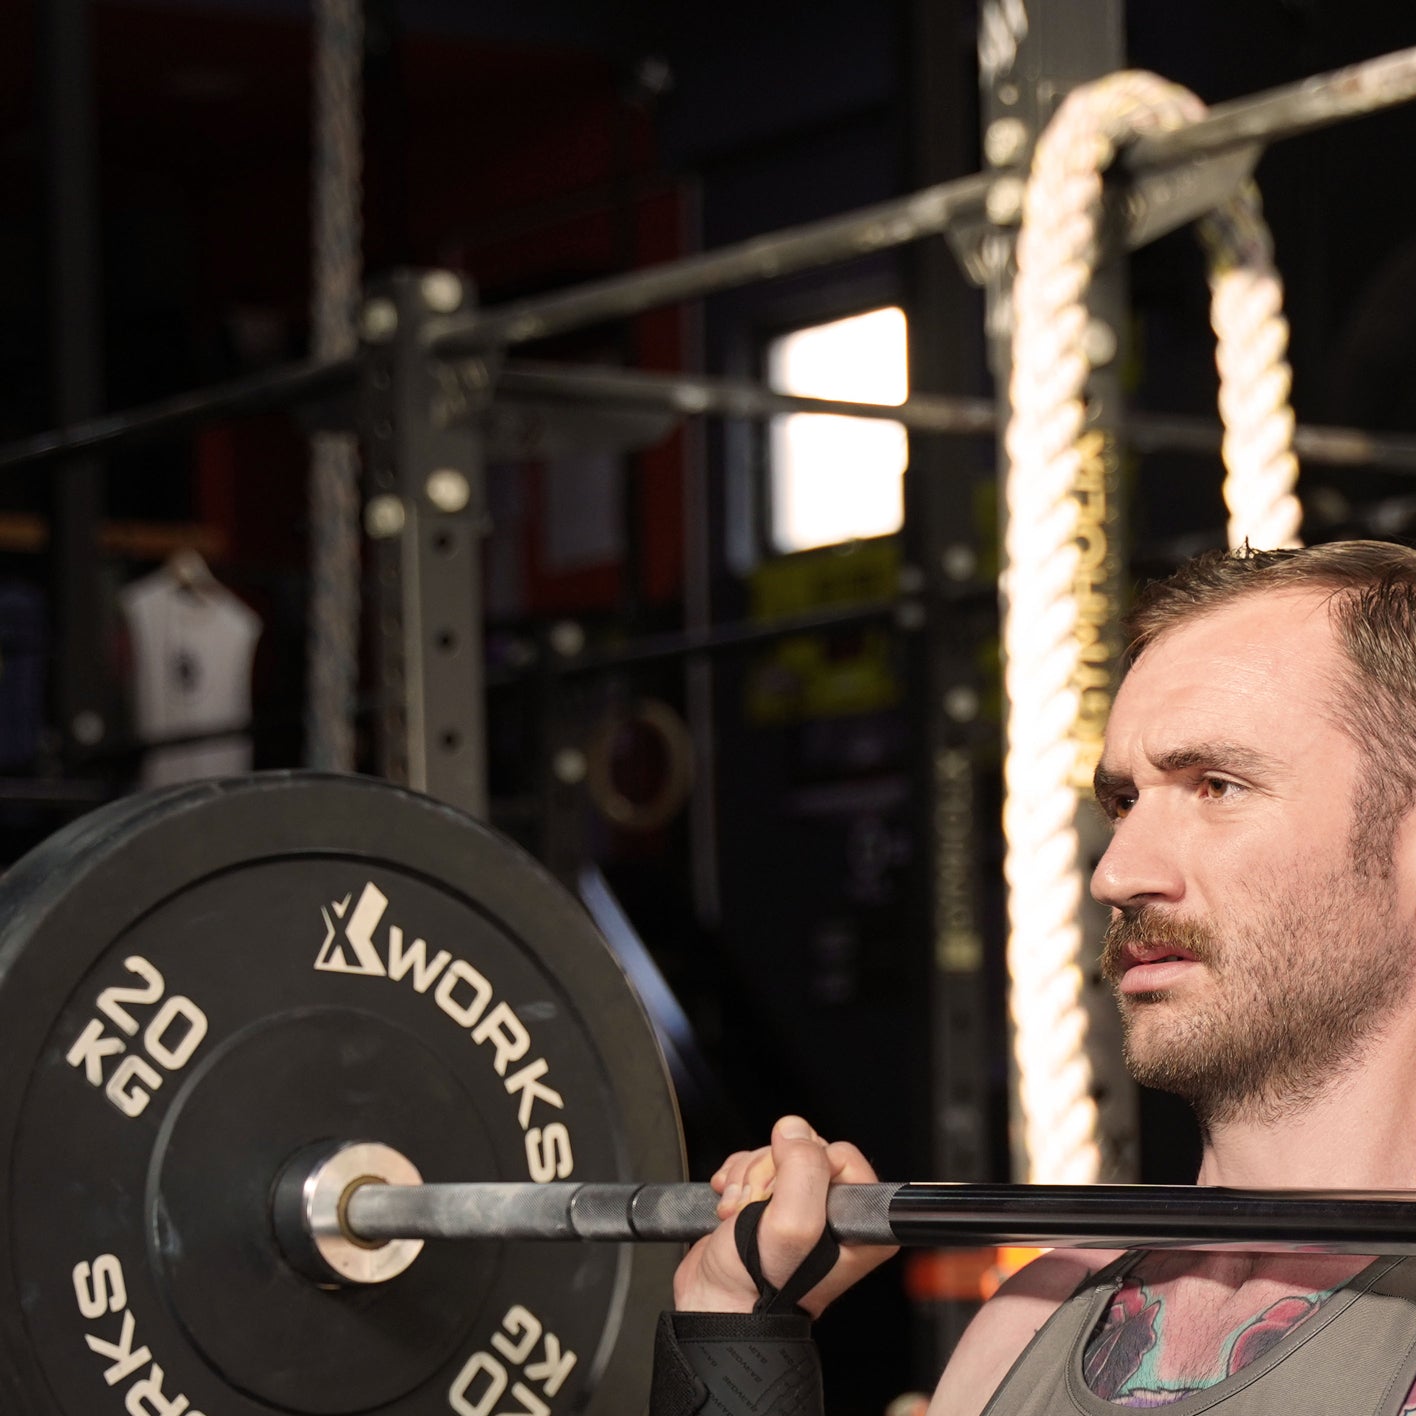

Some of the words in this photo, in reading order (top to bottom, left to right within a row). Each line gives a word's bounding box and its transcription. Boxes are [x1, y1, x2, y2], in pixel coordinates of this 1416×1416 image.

[96, 955, 208, 1070] 20
[66, 1018, 163, 1117] KG
[490, 1304, 577, 1397] KG
